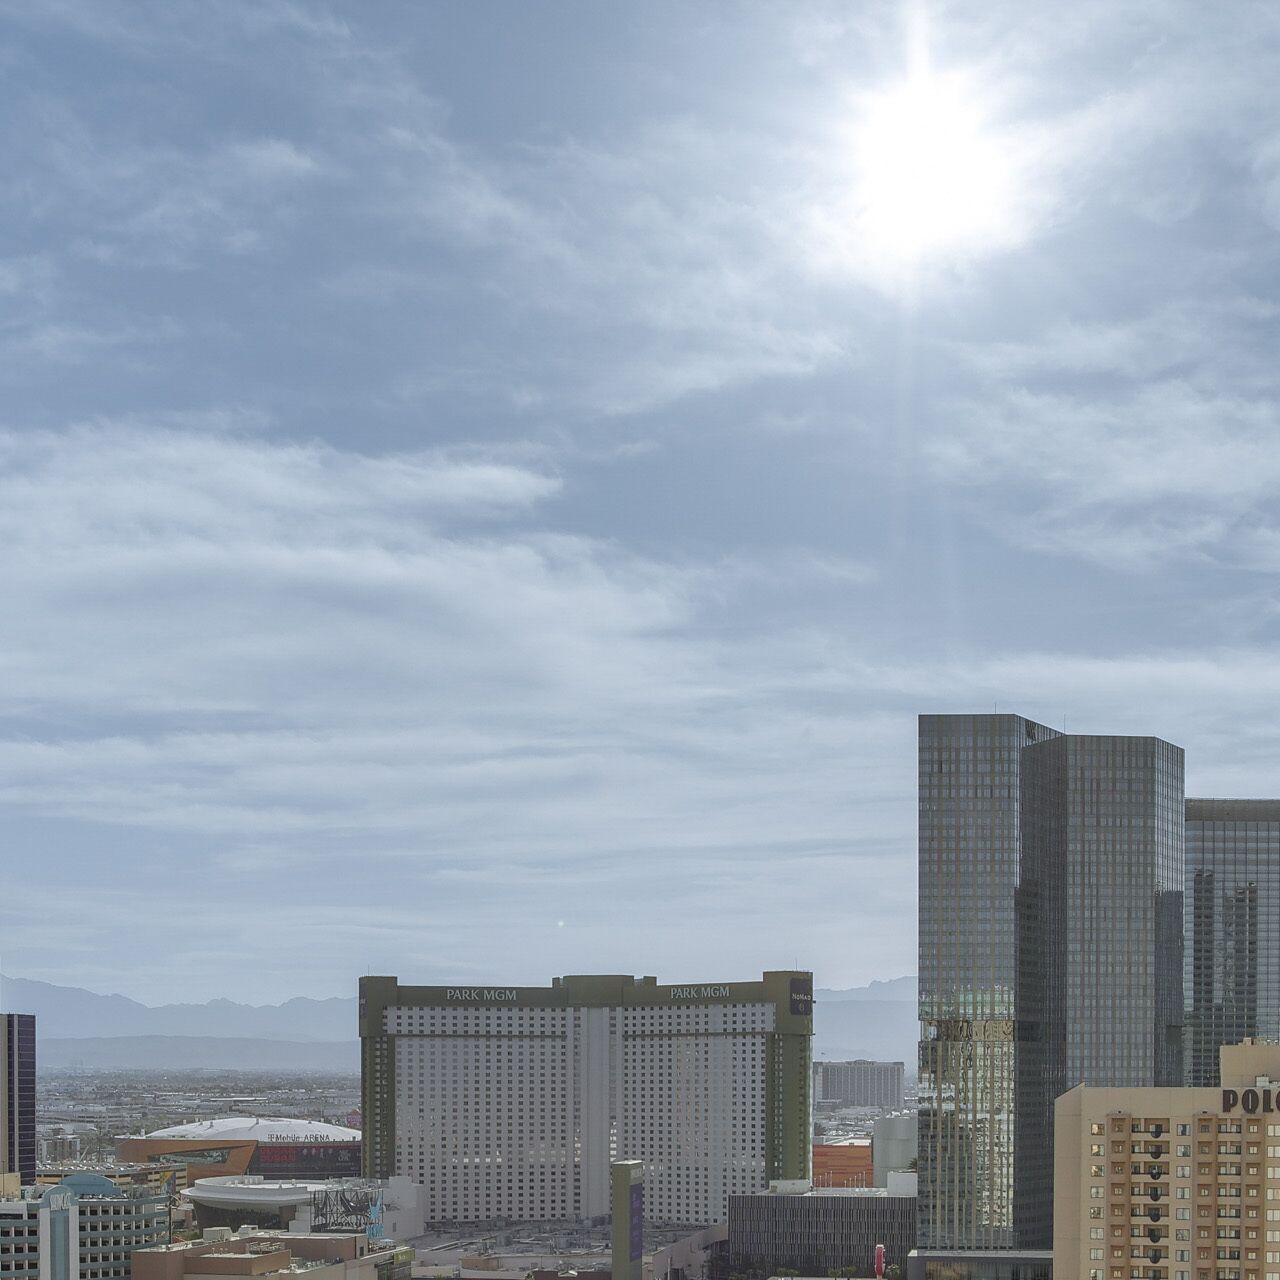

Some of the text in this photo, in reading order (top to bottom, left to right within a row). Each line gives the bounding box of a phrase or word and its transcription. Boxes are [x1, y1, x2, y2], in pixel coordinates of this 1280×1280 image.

[446, 989, 517, 1001] PARK MGM
[671, 986, 730, 999] PARK MGM
[304, 1133, 331, 1142] ARENA
